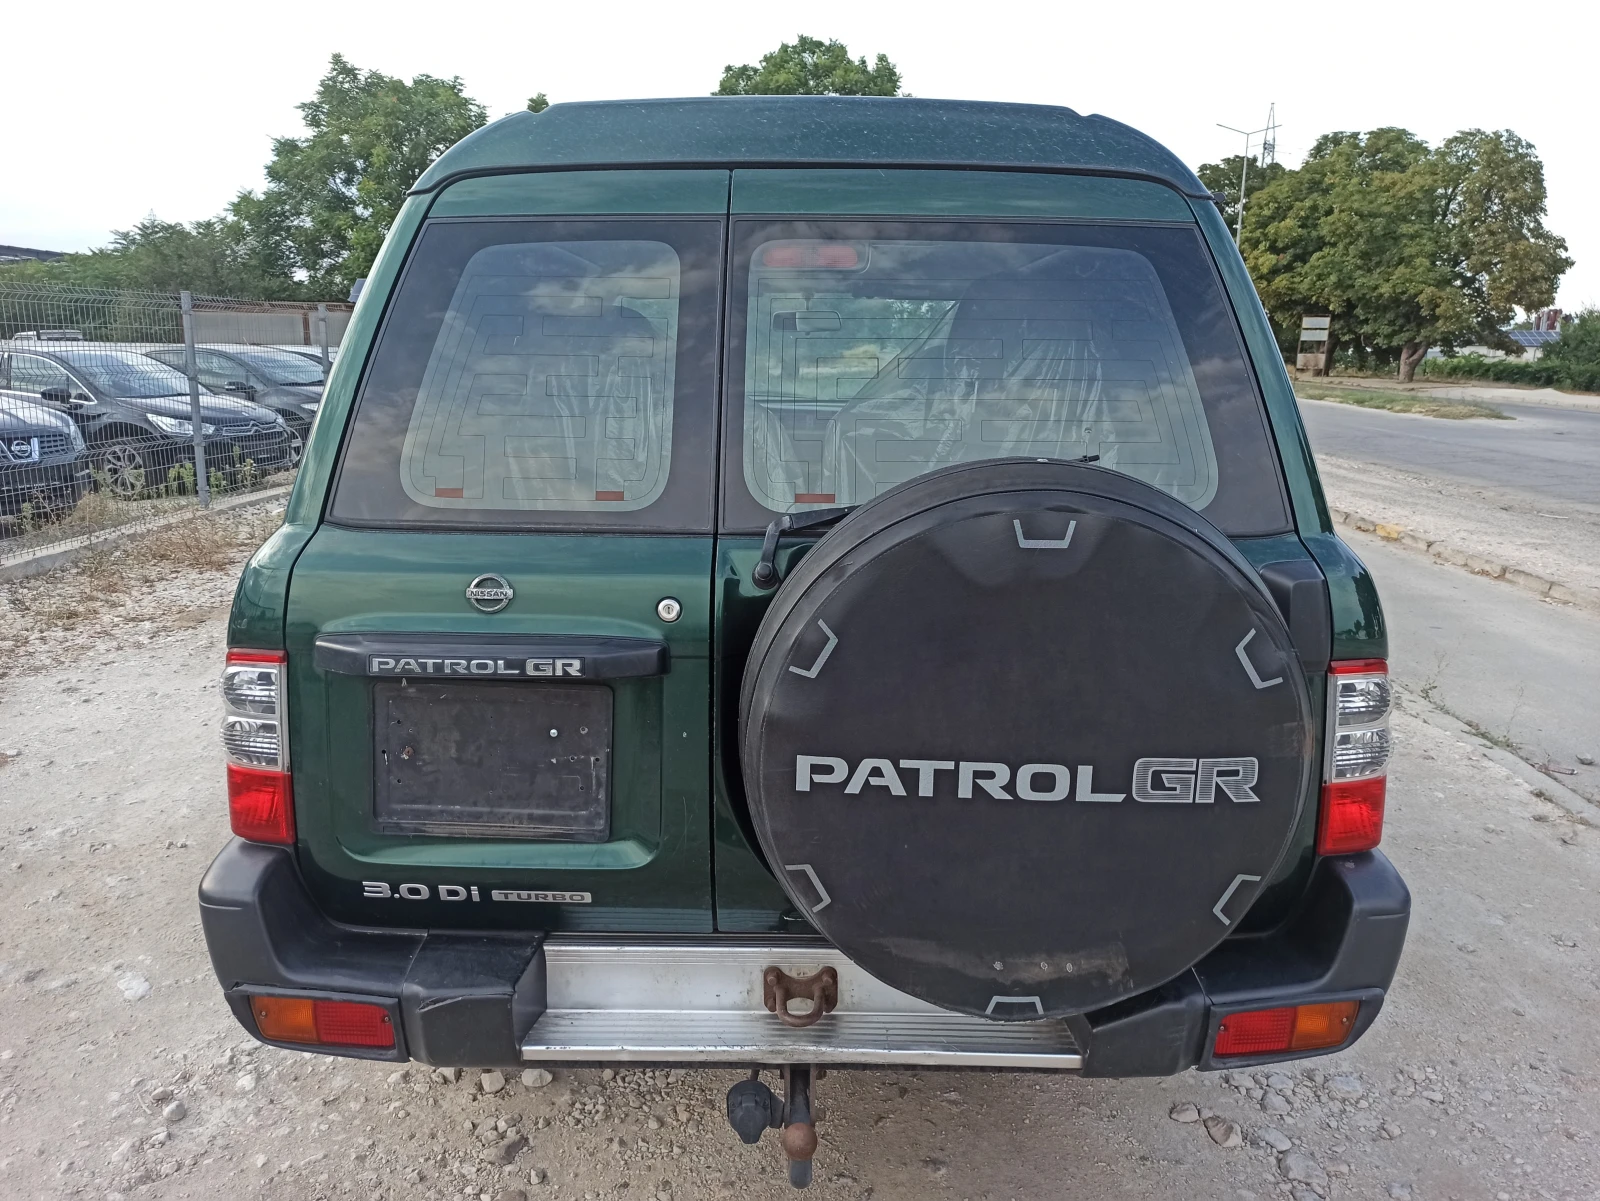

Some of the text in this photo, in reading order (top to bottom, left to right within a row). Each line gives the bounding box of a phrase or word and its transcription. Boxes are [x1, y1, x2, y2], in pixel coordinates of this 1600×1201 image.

[470, 589, 508, 599] NISSAN
[371, 658, 582, 676] PATROL GR
[796, 754, 1260, 803] PATROL GR
[362, 881, 586, 903] 3.0 Di TURBO
